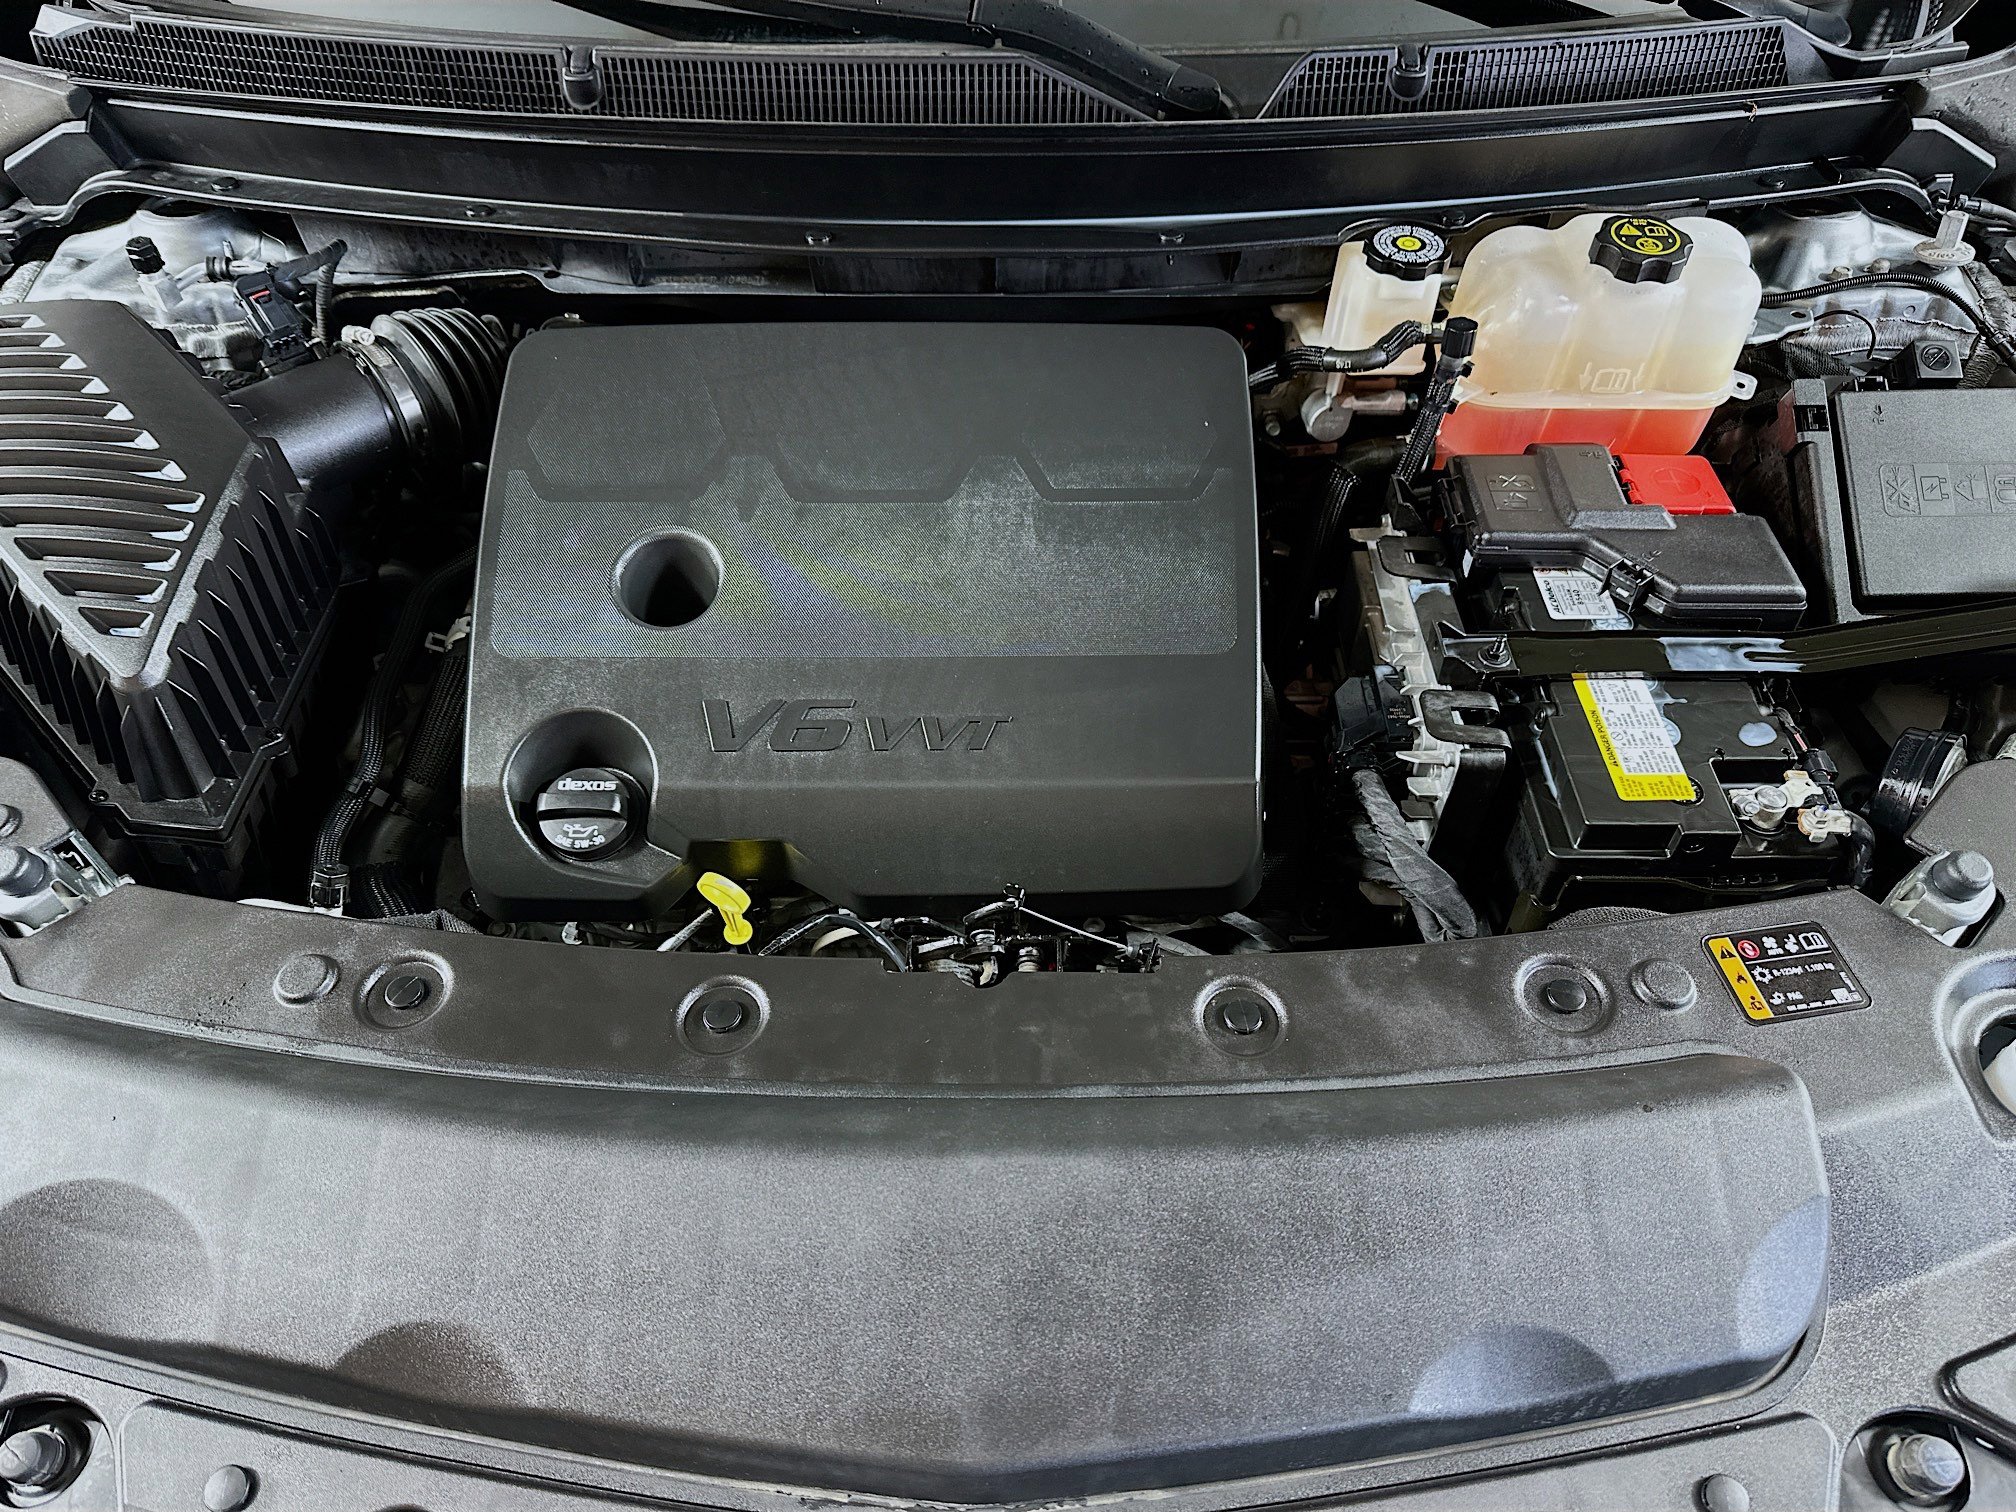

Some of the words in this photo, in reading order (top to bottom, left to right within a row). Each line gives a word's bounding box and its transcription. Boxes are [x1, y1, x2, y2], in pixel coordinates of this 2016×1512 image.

[702, 699, 857, 753] V6
[865, 715, 1014, 752] VVT
[1588, 708, 1605, 734] POISON
[1600, 733, 1616, 762] DANGER
[557, 777, 619, 791] dexos
[554, 834, 574, 848] SAE
[573, 834, 606, 849] 5W-30
